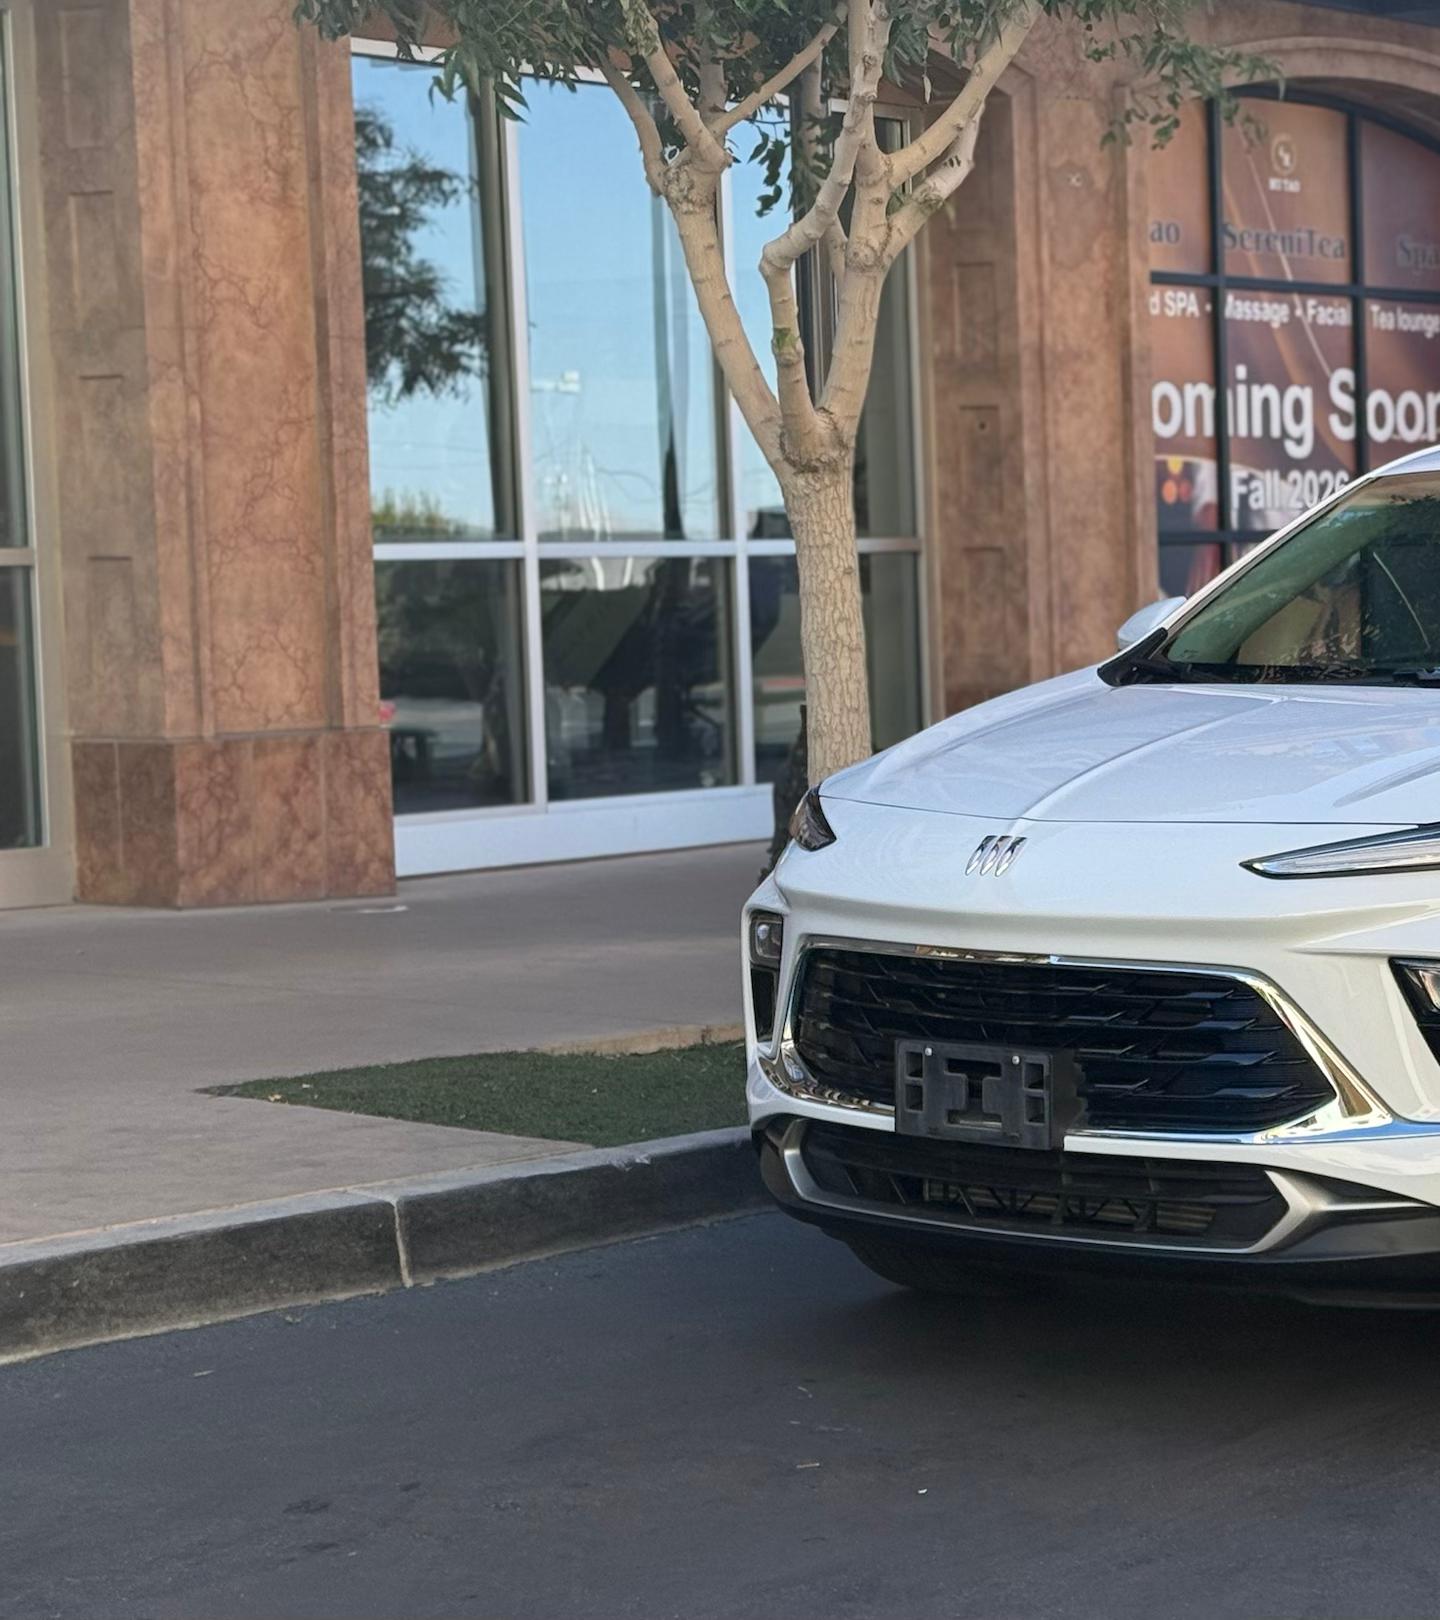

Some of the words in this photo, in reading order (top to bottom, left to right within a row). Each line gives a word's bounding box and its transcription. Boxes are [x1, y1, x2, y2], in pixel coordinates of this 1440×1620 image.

[1150, 221, 1181, 244] ao
[1164, 291, 1200, 318] SPA
[1306, 299, 1352, 325] Facial
[1370, 305, 1395, 331] Tea
[1151, 364, 1314, 459] oming
[1231, 471, 1281, 511] Fall
